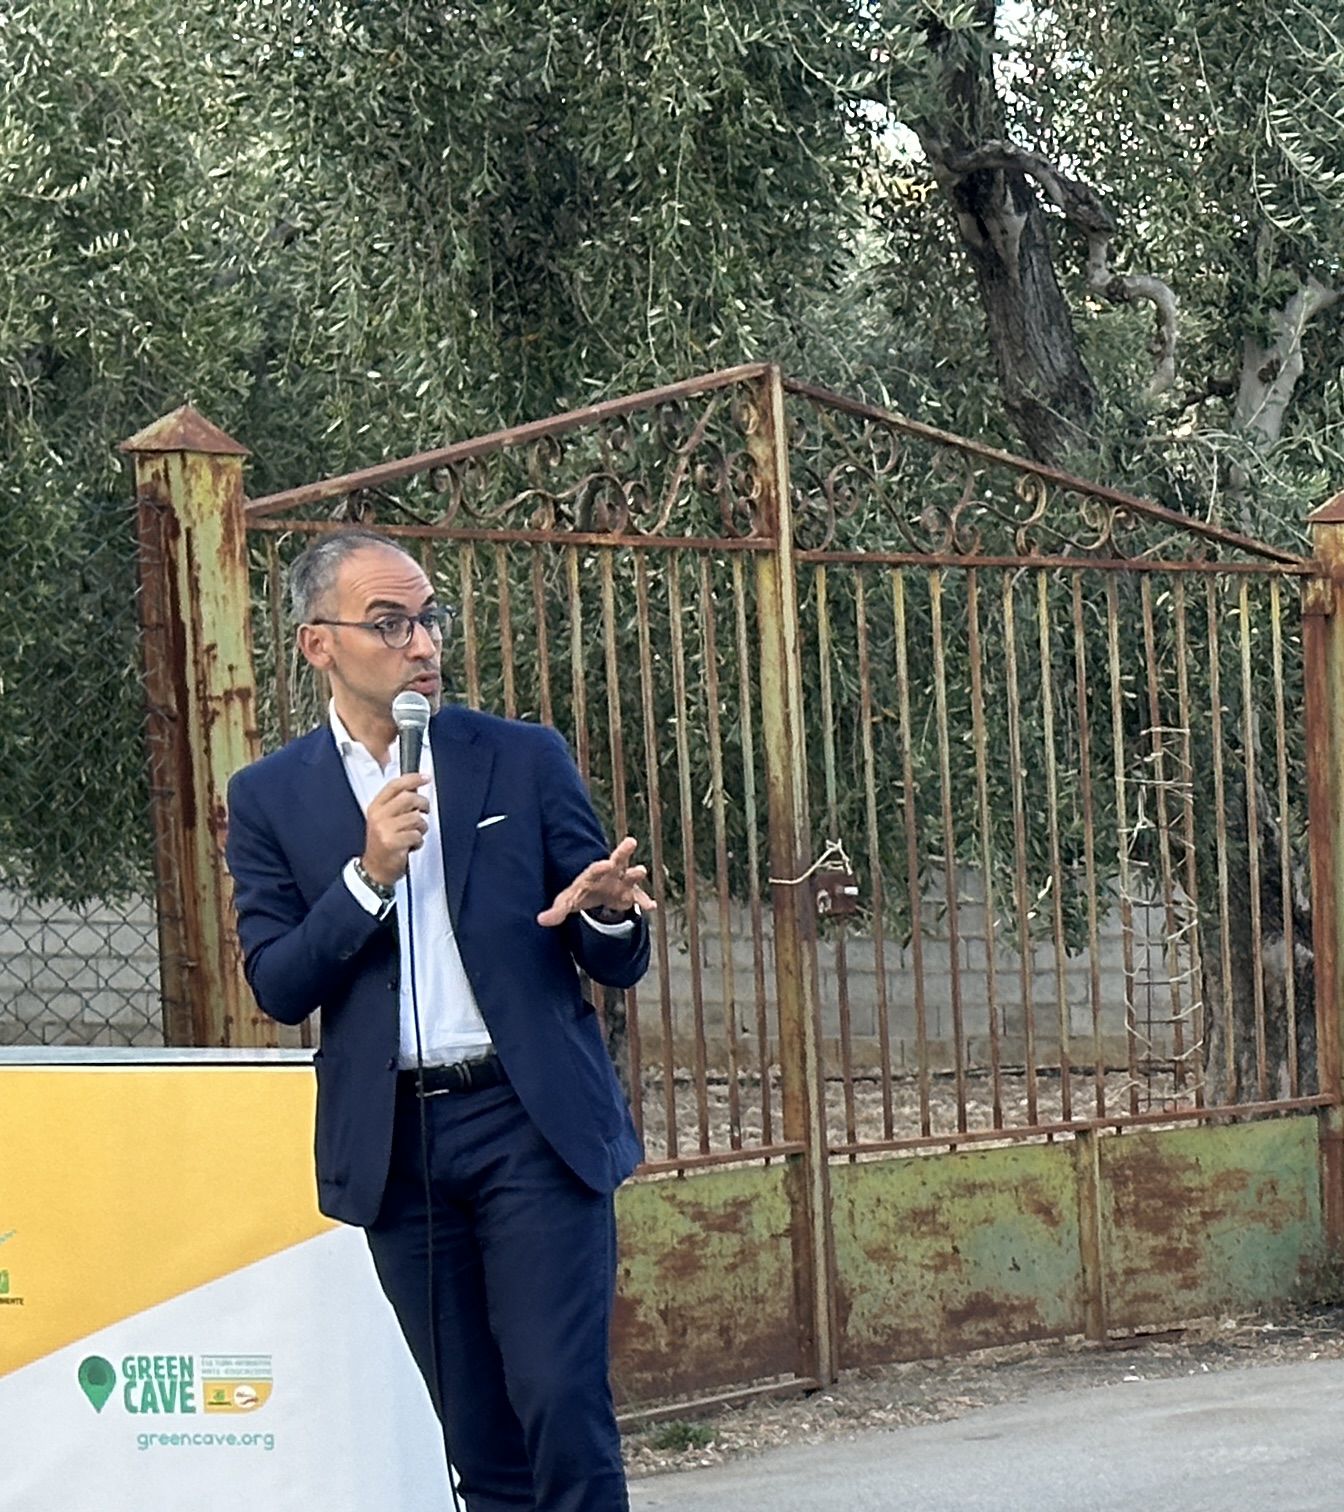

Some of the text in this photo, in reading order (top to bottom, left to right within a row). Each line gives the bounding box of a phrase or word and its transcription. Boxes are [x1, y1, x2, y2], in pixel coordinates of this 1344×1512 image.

[122, 1355, 194, 1380] GREEN
[123, 1381, 196, 1414] CAVE
[137, 1433, 275, 1450] greencave.org
